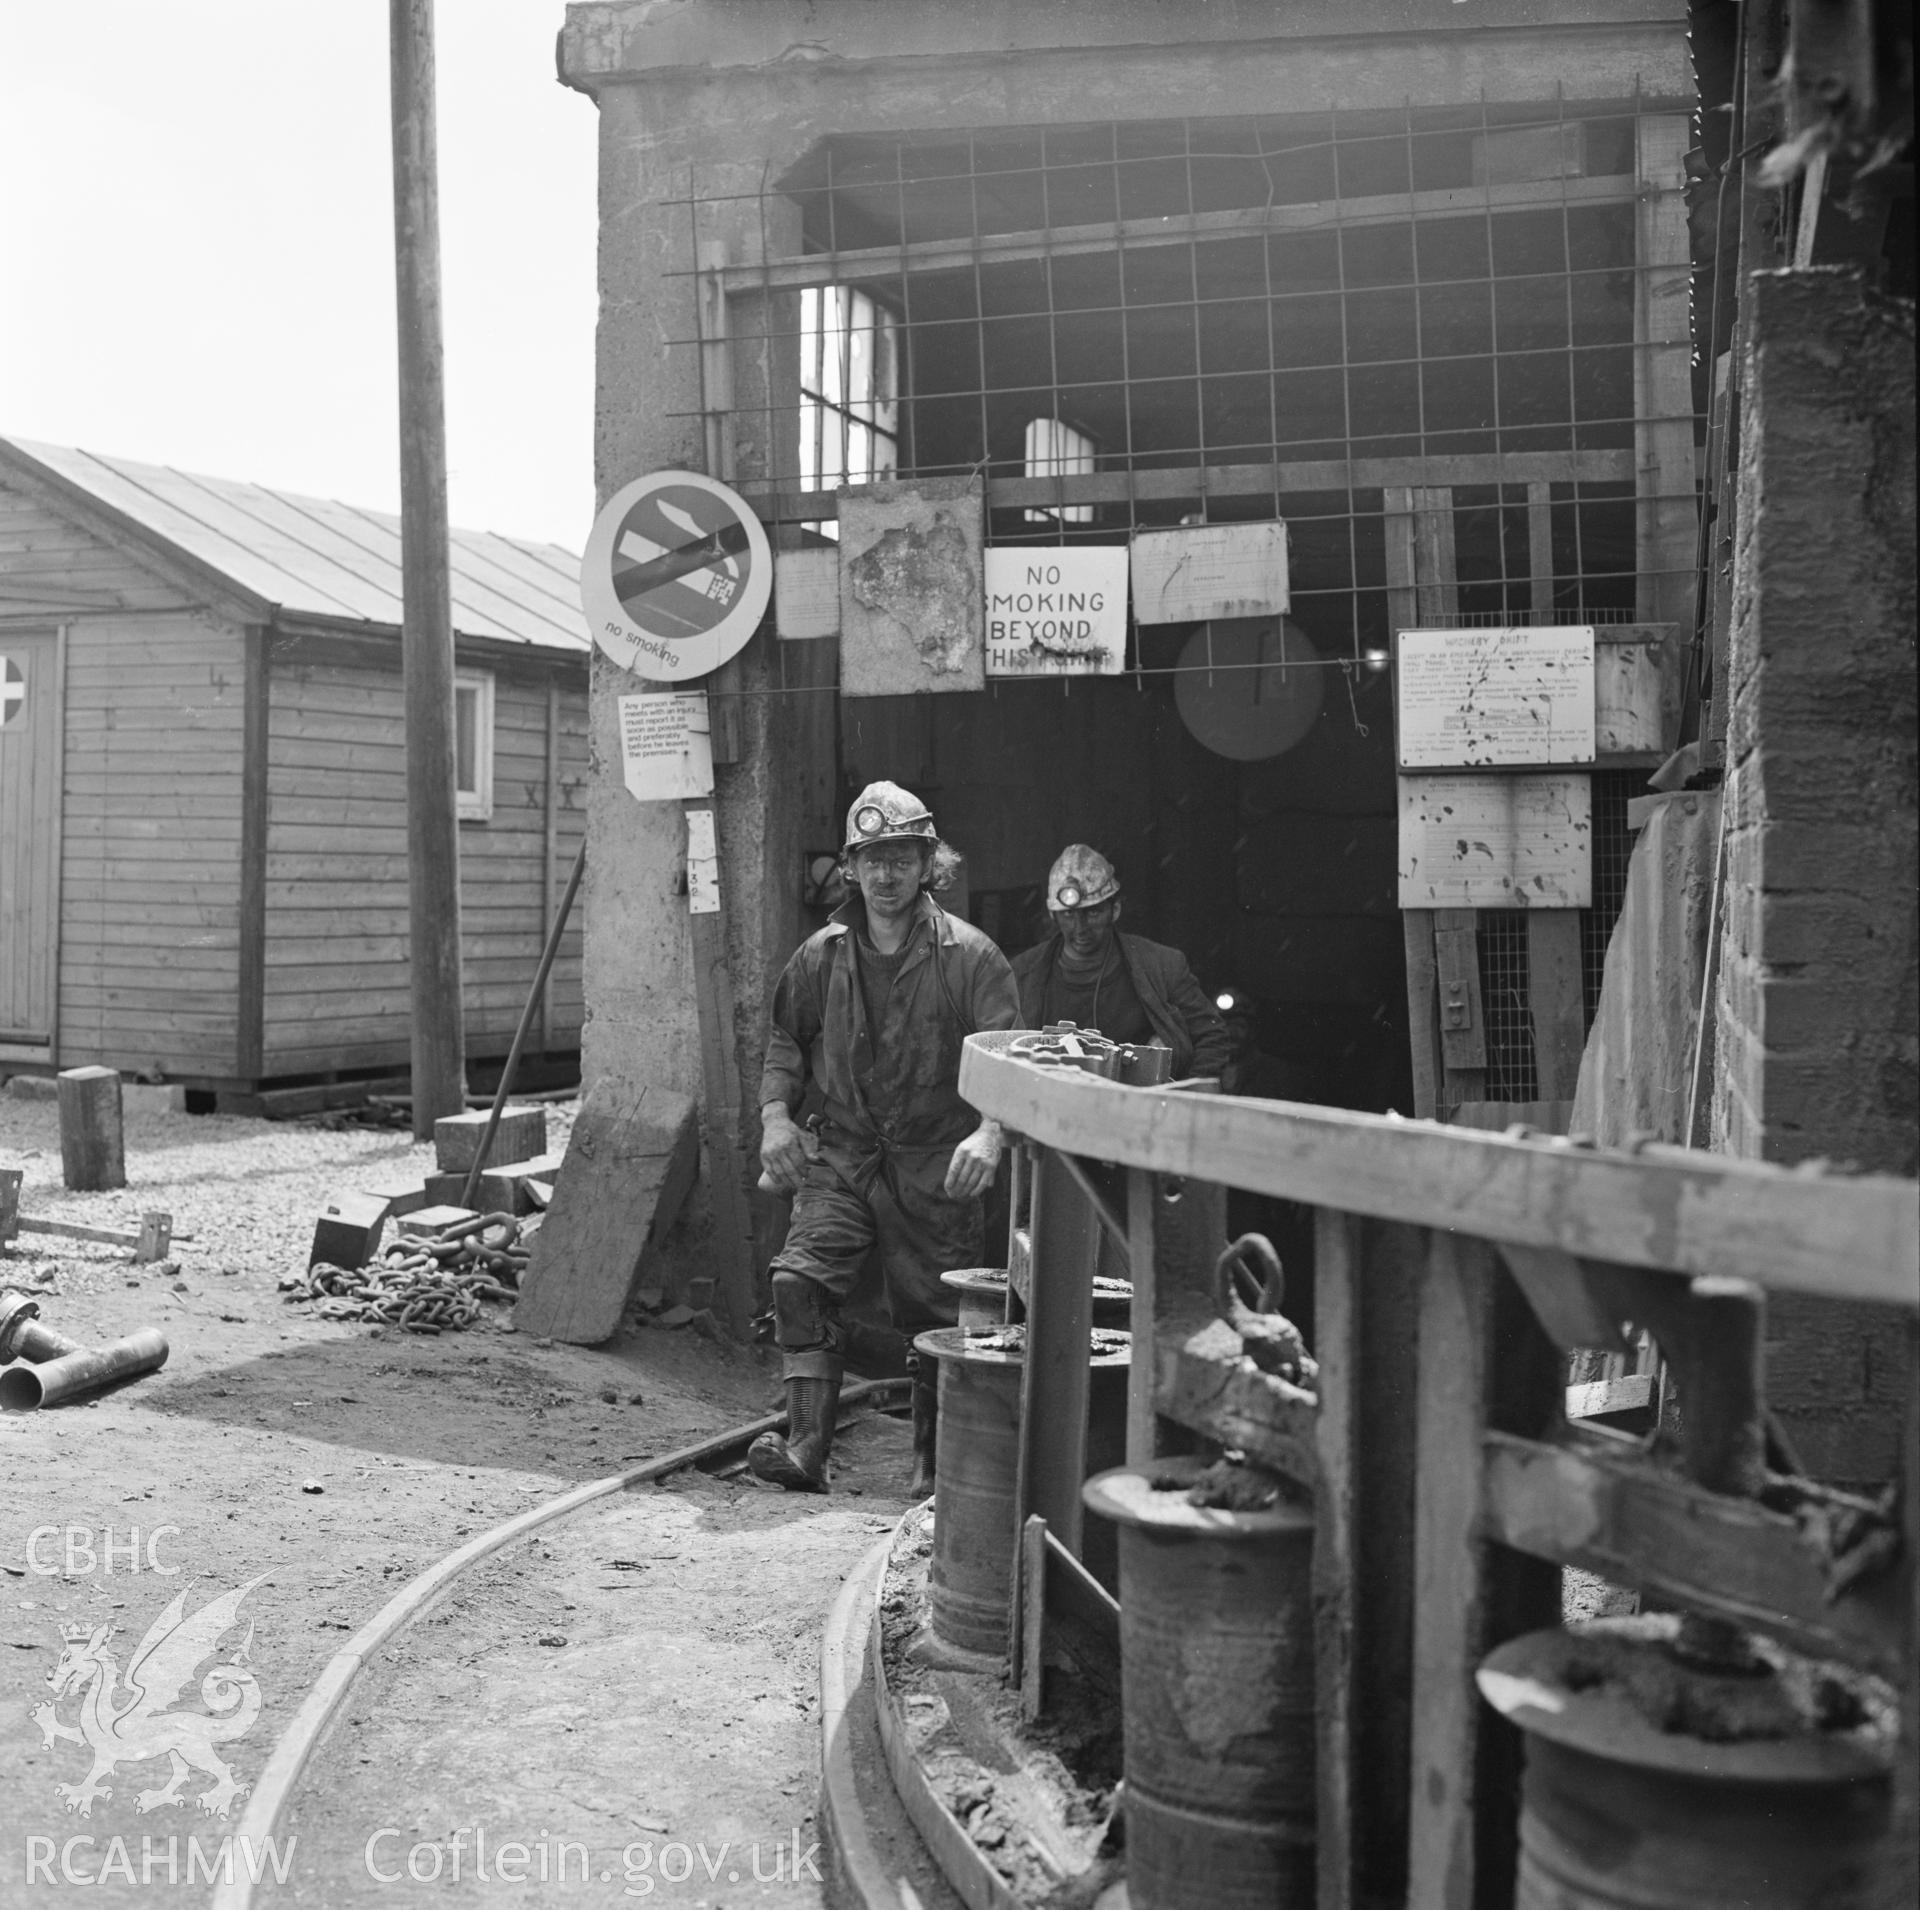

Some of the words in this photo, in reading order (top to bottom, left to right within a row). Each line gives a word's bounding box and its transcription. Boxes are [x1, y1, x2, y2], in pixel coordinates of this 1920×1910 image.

[1027, 565, 1061, 585] NO
[990, 620, 1091, 640] BEYOND
[604, 621, 623, 637] no
[625, 631, 680, 668] smoking
[624, 702, 638, 710] Any
[641, 701, 667, 709] person
[645, 716, 668, 725] report
[658, 723, 689, 733] possible
[643, 732, 680, 742] preferably
[690, 873, 698, 885] 3
[691, 887, 699, 897] 2
